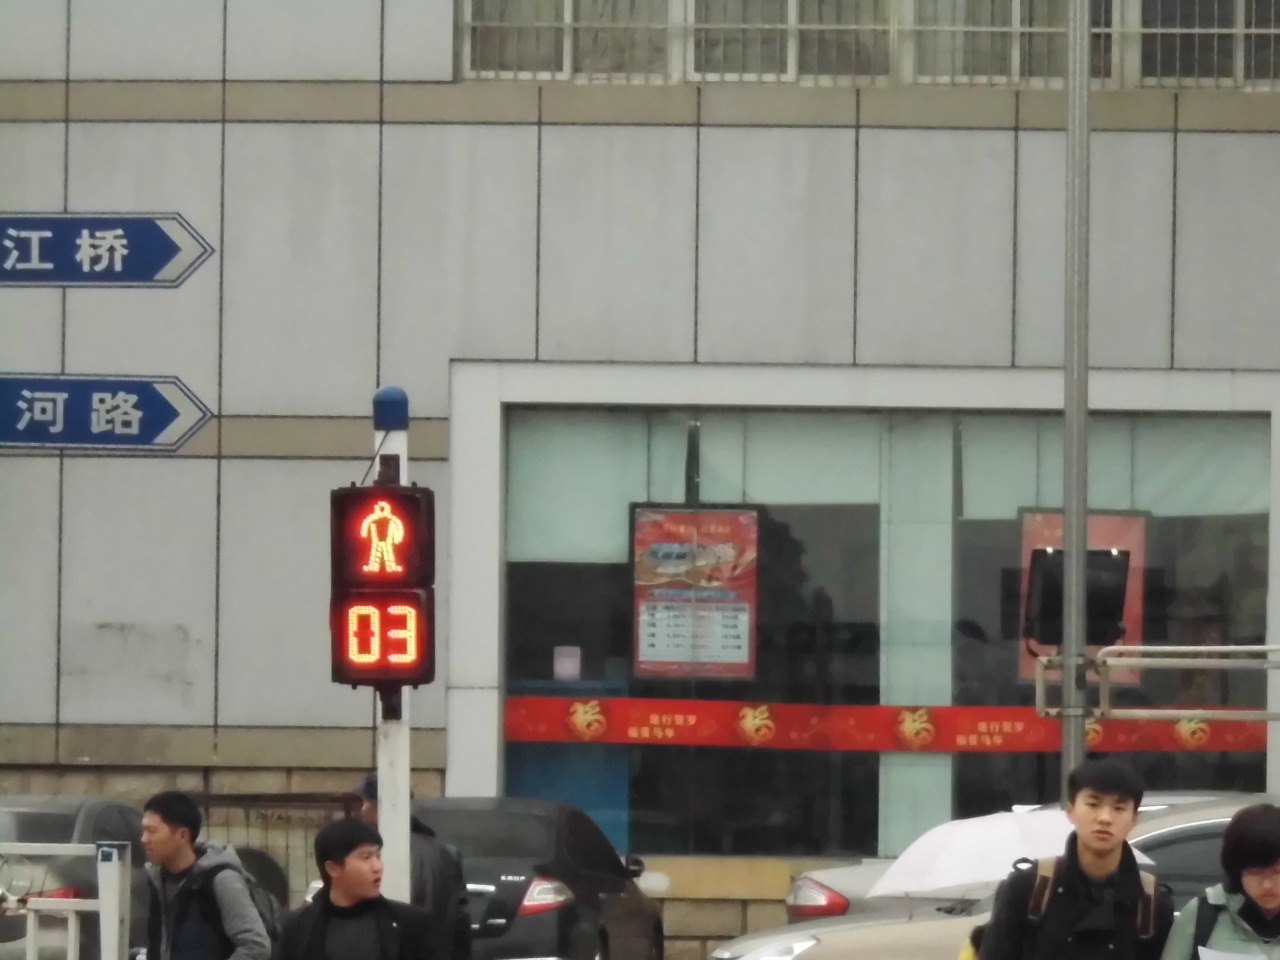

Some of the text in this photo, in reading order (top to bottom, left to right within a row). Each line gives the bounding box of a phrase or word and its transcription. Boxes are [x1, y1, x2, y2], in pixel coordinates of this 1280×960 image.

[3, 228, 129, 273] 江桥
[16, 389, 143, 435] 河路
[348, 604, 418, 663] 03
